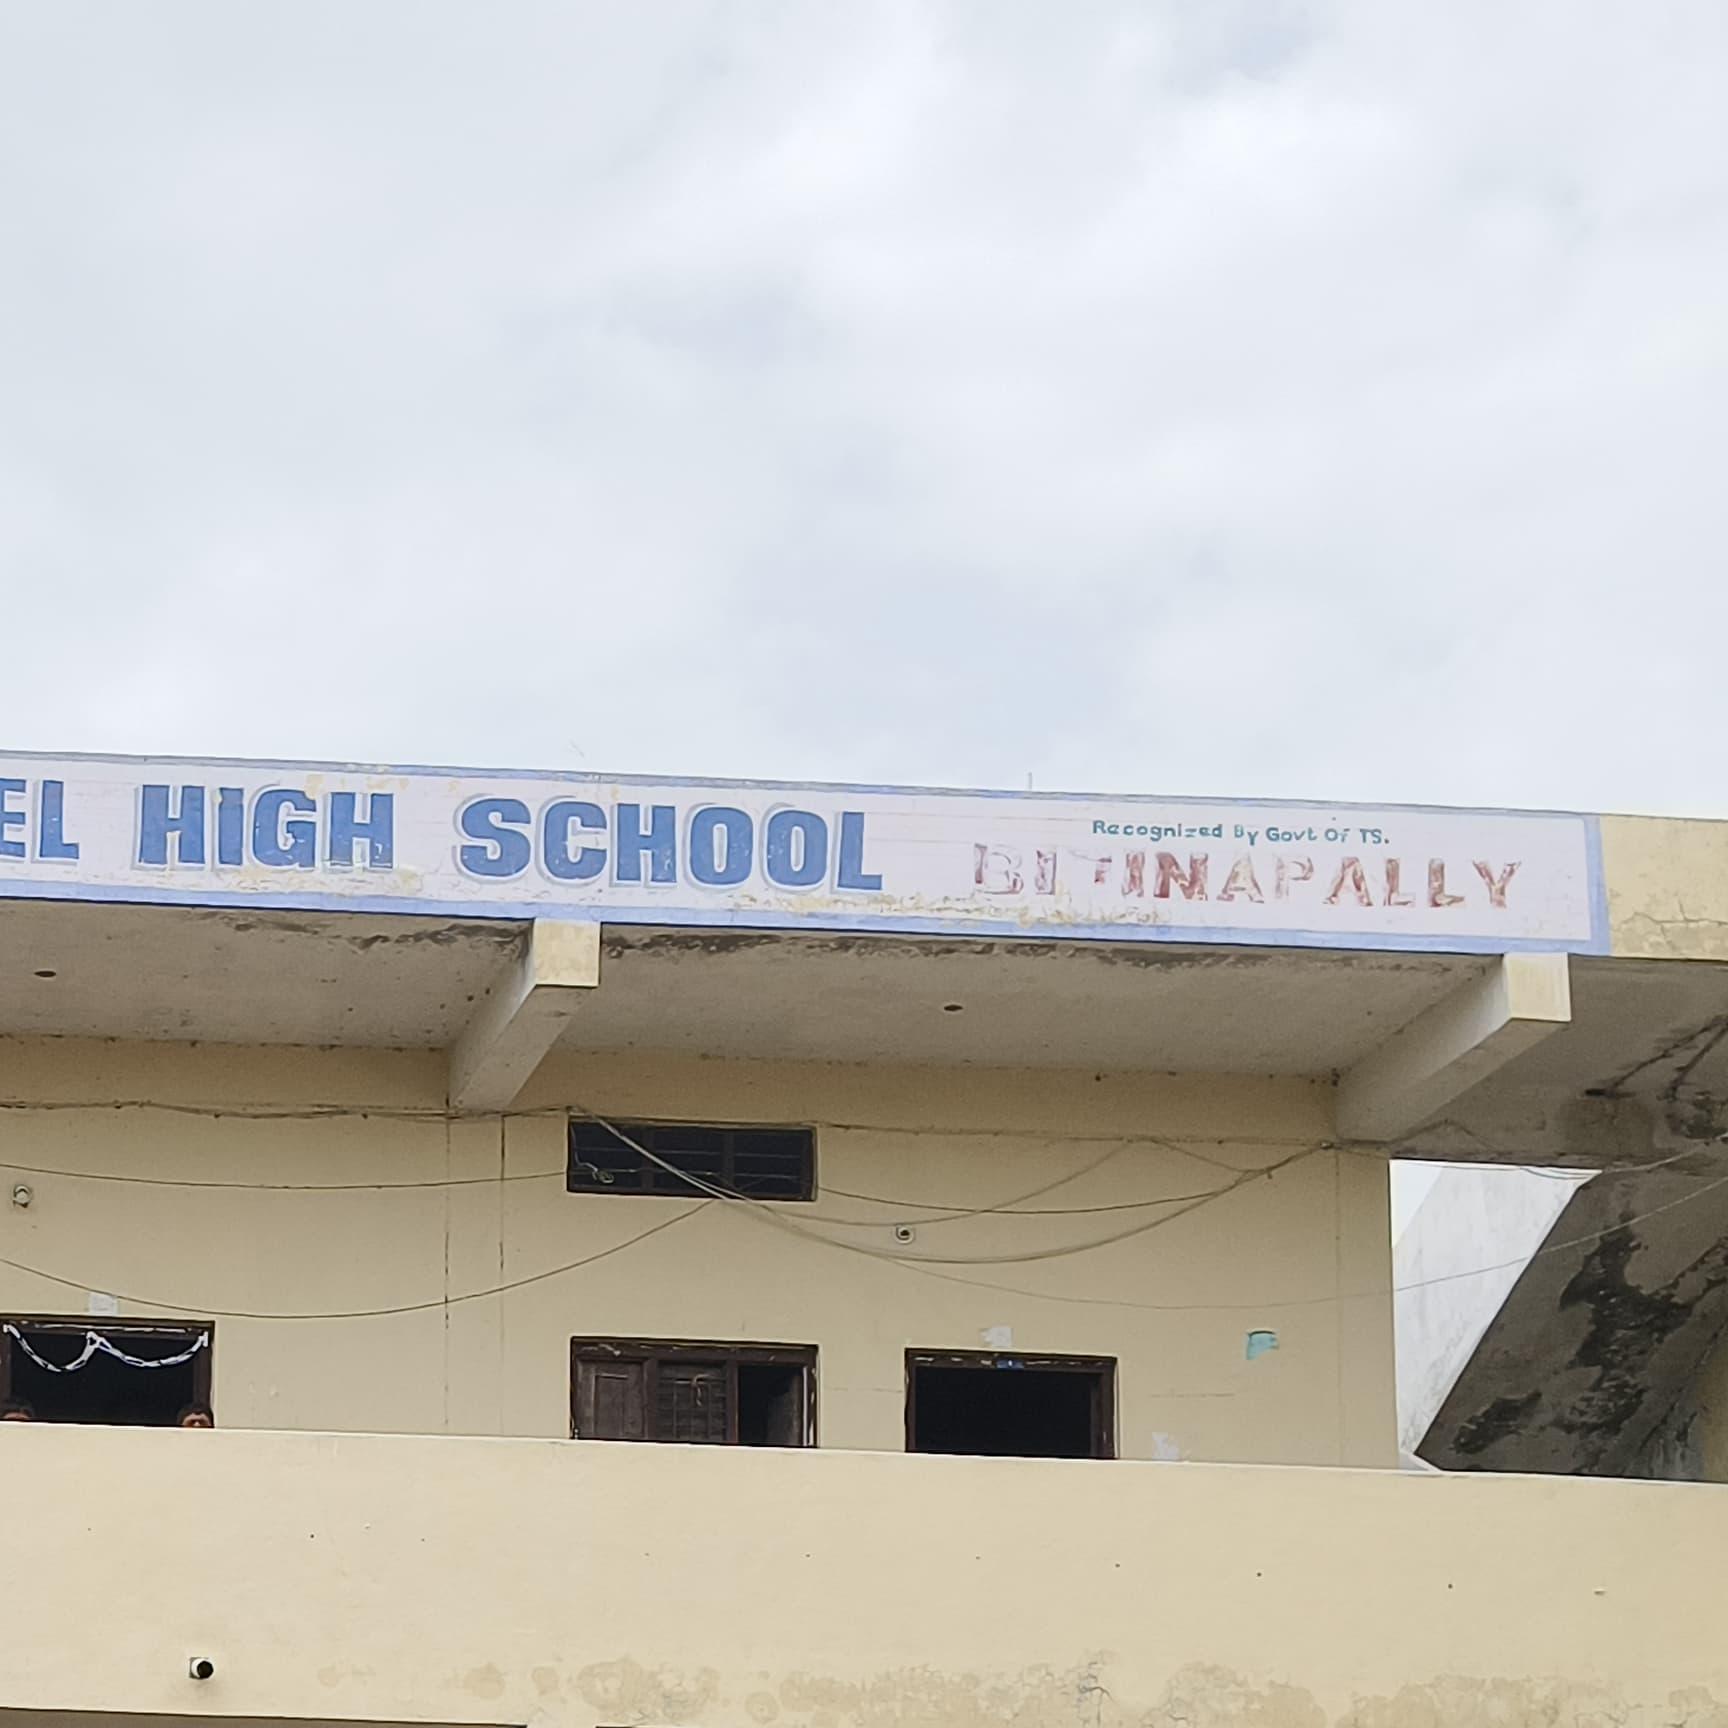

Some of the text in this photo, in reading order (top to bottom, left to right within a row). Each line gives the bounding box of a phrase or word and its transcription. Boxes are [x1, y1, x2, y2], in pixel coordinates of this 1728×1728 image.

[139, 783, 395, 869] HIGH
[459, 798, 883, 891] SCHOOL
[1092, 820, 1223, 842] Recognized
[1234, 824, 1259, 846] By
[1266, 827, 1317, 843] Govt
